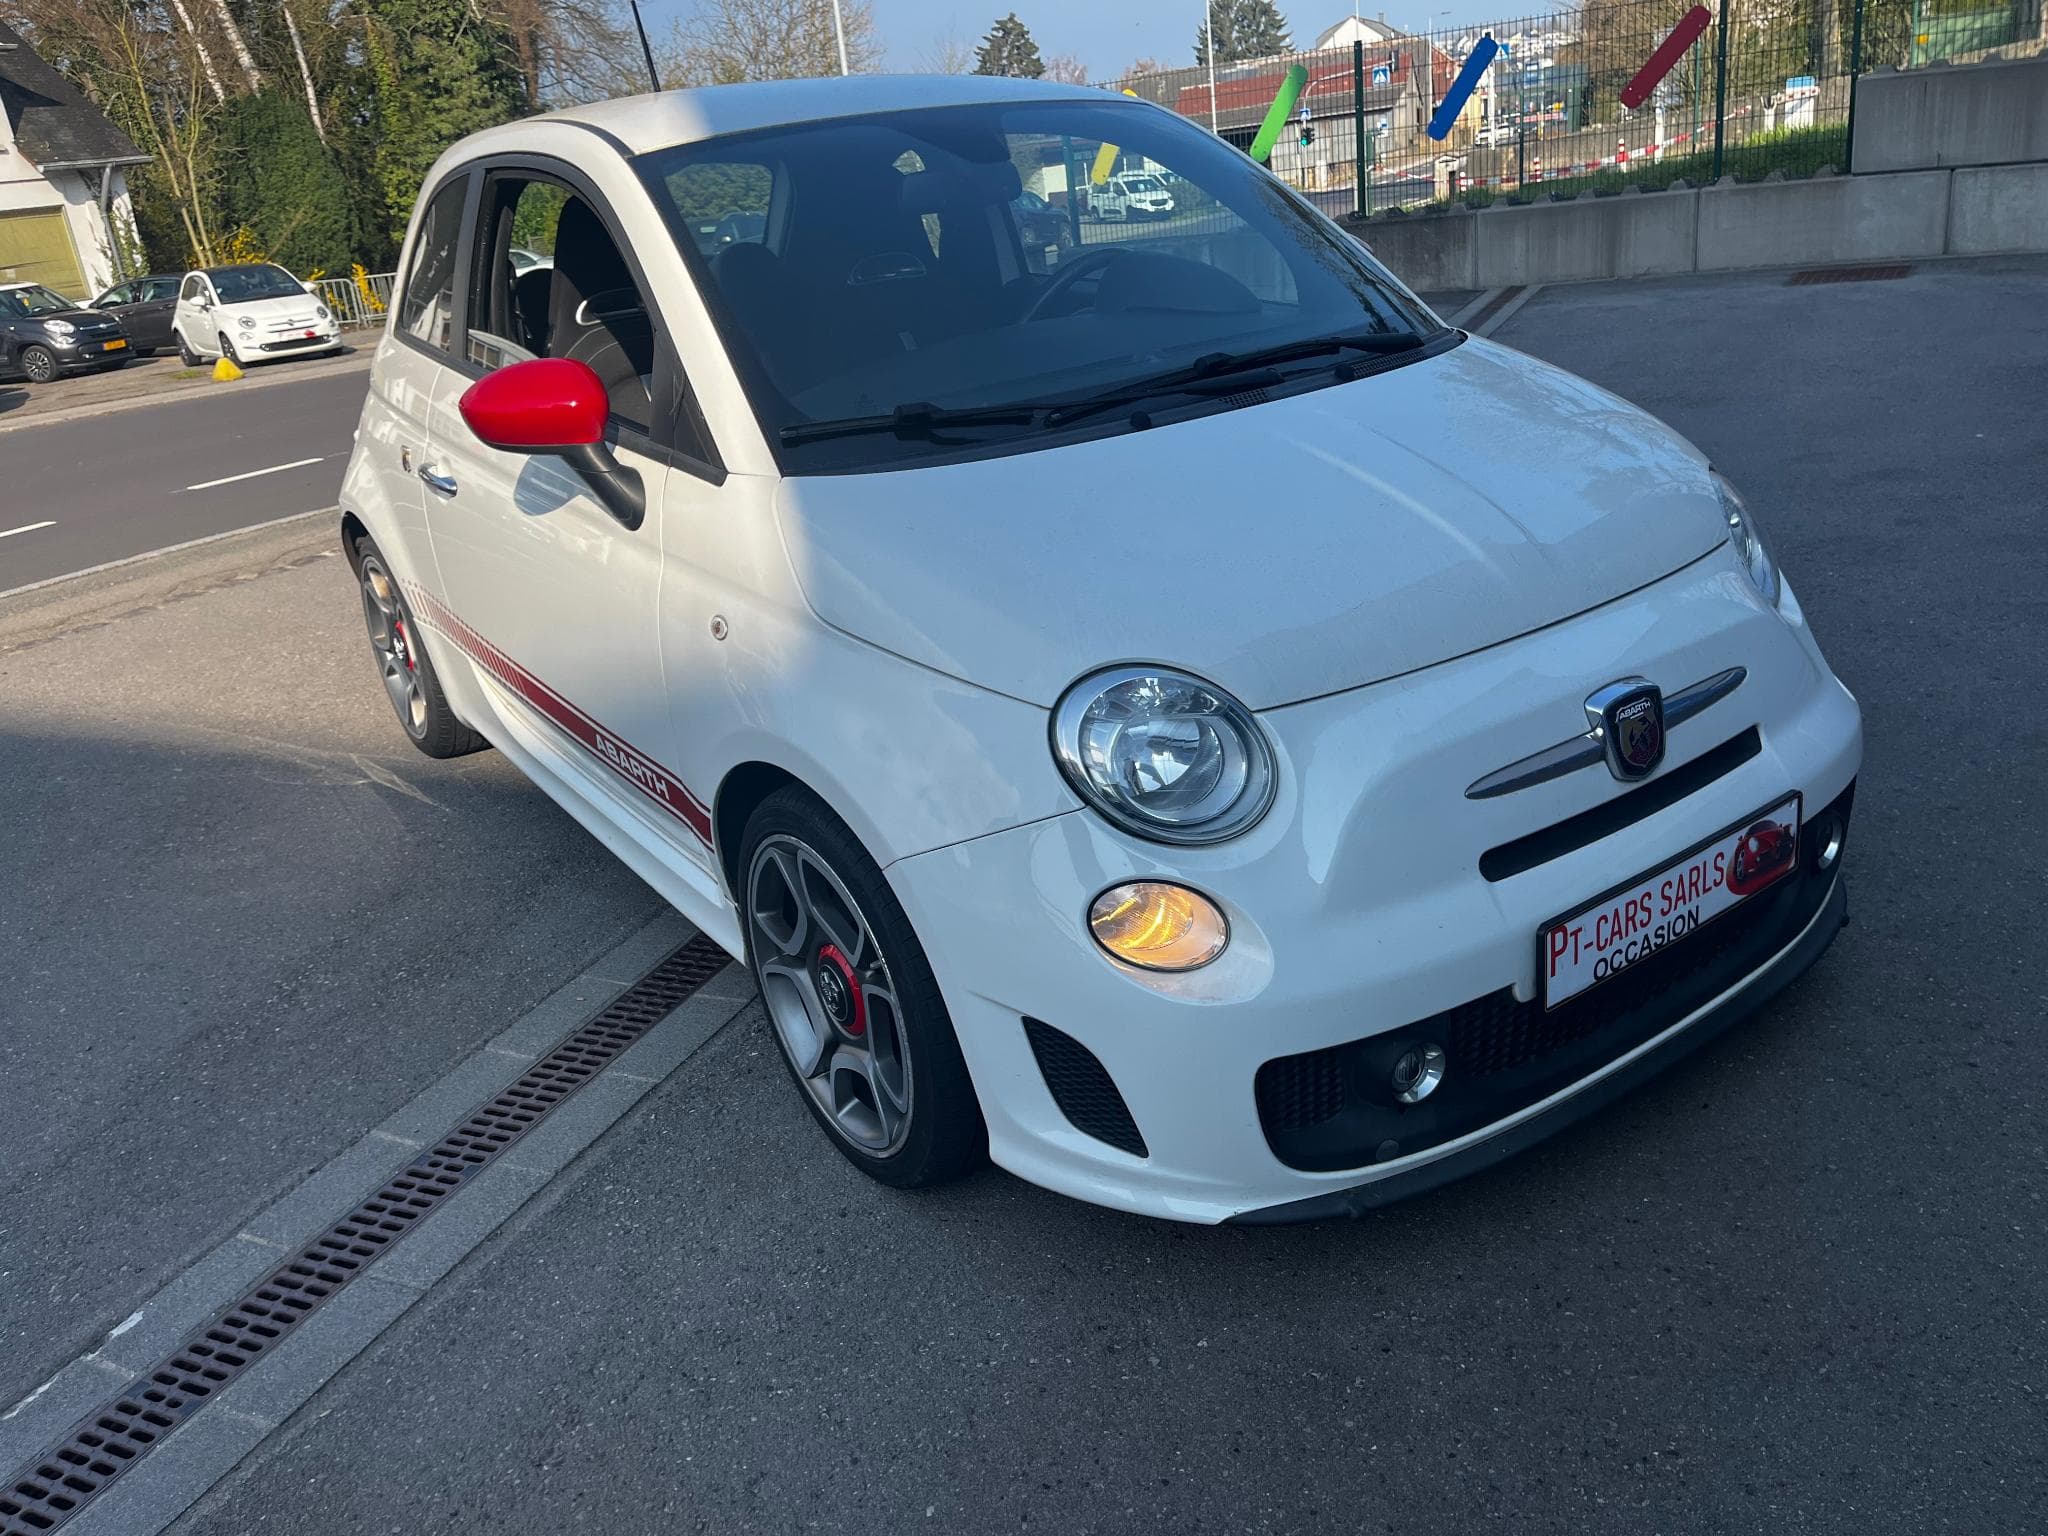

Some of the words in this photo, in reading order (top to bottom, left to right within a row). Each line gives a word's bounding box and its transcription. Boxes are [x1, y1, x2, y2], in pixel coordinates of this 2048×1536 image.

[1619, 701, 1651, 720] ABARTH
[596, 734, 670, 800] ABARTH
[1660, 852, 1725, 916] SARLS
[1593, 905, 1700, 981] OCCASION
